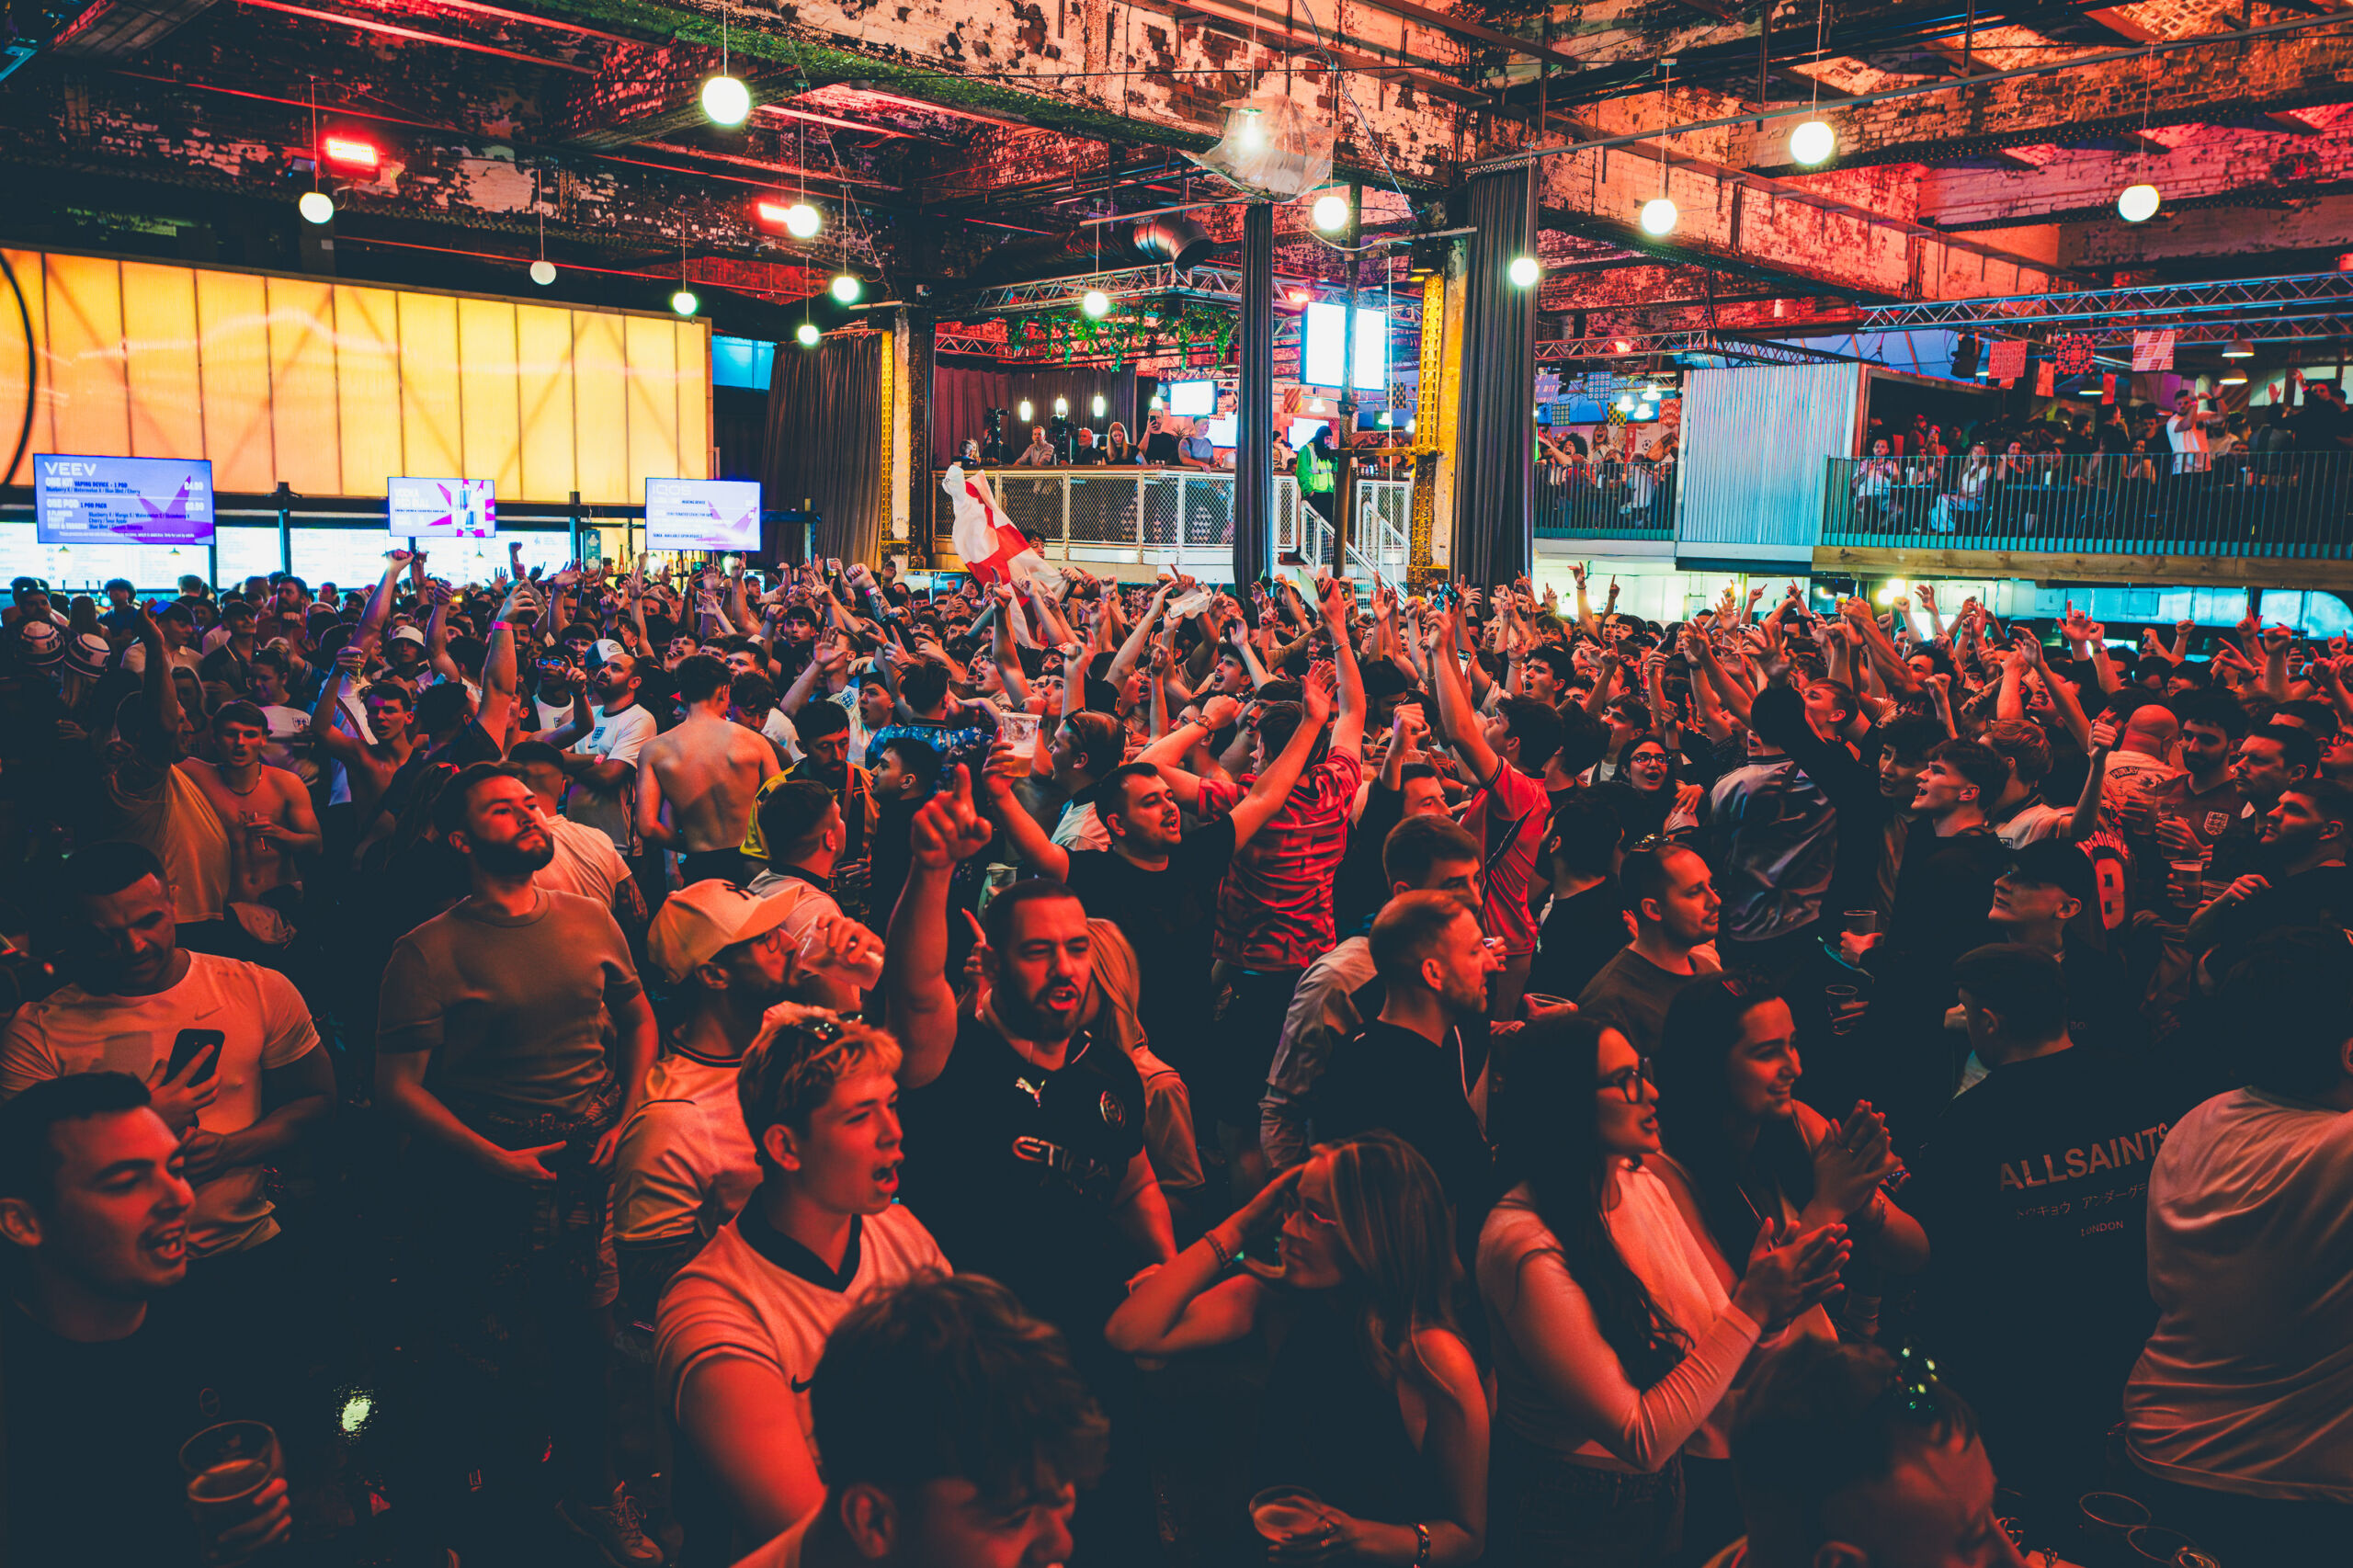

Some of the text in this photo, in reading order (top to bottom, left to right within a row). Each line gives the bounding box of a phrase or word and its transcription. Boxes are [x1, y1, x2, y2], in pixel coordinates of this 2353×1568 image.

[44, 461, 97, 476] VEEV
[653, 483, 692, 496] IQOS
[2095, 858, 2126, 931] 8
